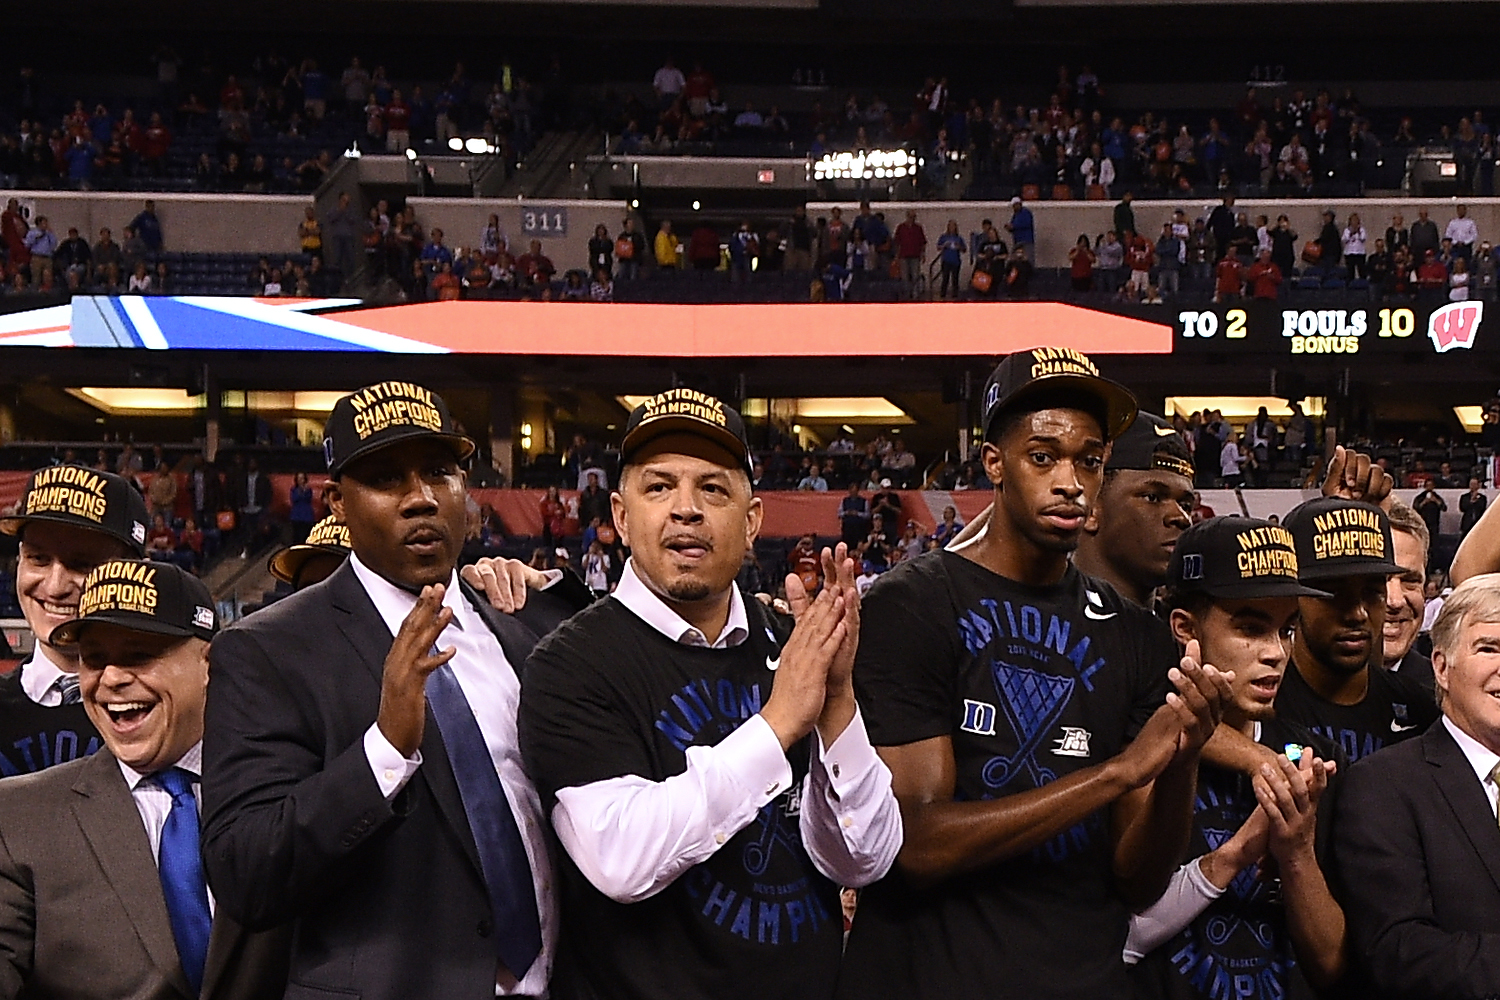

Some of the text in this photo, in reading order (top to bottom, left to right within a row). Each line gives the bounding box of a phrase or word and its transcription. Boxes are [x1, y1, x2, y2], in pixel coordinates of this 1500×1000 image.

[1249, 65, 1286, 80] 412
[525, 212, 563, 230] 311
[1179, 309, 1247, 338] TO 2
[1282, 308, 1415, 338] FOULS 10
[1291, 337, 1359, 354] BONUS
[350, 381, 436, 413] NATIONAL
[645, 388, 724, 415] NATIONAL
[354, 400, 442, 434] CHAMPIONS
[34, 466, 108, 498] NATIONAL
[26, 487, 107, 517] CHAMPIONS
[1314, 509, 1382, 533] NATIONAL
[1314, 531, 1385, 553] CHAMPIONS
[85, 561, 158, 593] NATIONAL
[79, 583, 158, 613] CHAMPIONS
[957, 598, 1107, 692] NATIONAL
[960, 699, 997, 736] D
